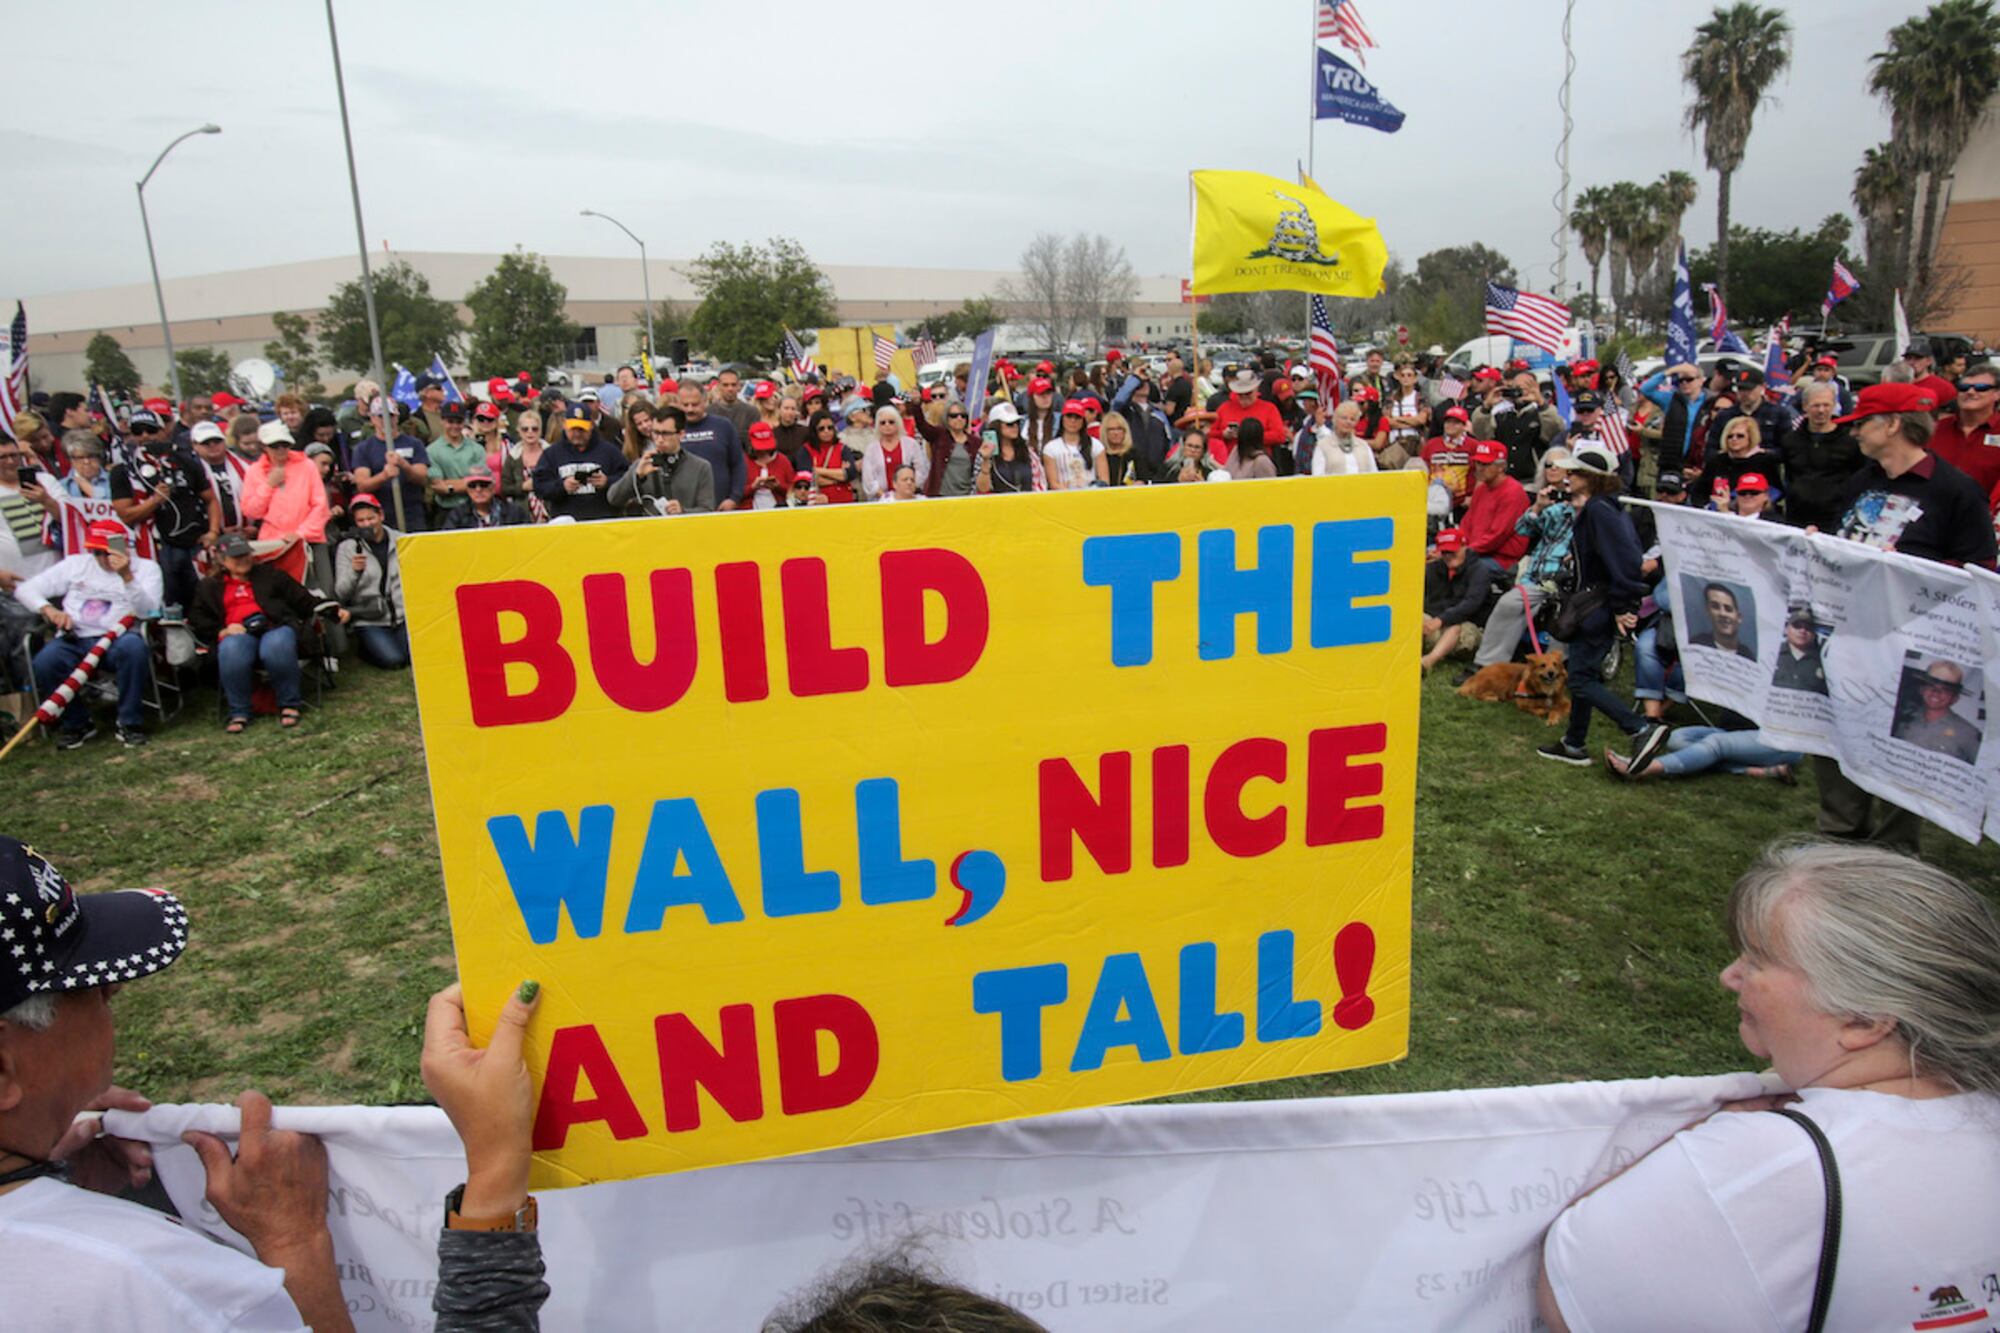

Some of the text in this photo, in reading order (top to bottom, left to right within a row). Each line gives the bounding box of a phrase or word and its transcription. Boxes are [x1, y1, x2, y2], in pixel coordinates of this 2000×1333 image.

[1321, 63, 1376, 97] TRU
[1313, 270, 1333, 282] ON
[1333, 269, 1354, 282] ME
[684, 430, 714, 439] RUMP
[456, 517, 1395, 727] BUILD THE
[487, 723, 1387, 945] WALL, NICE
[530, 921, 1377, 1152] AND TALL!
